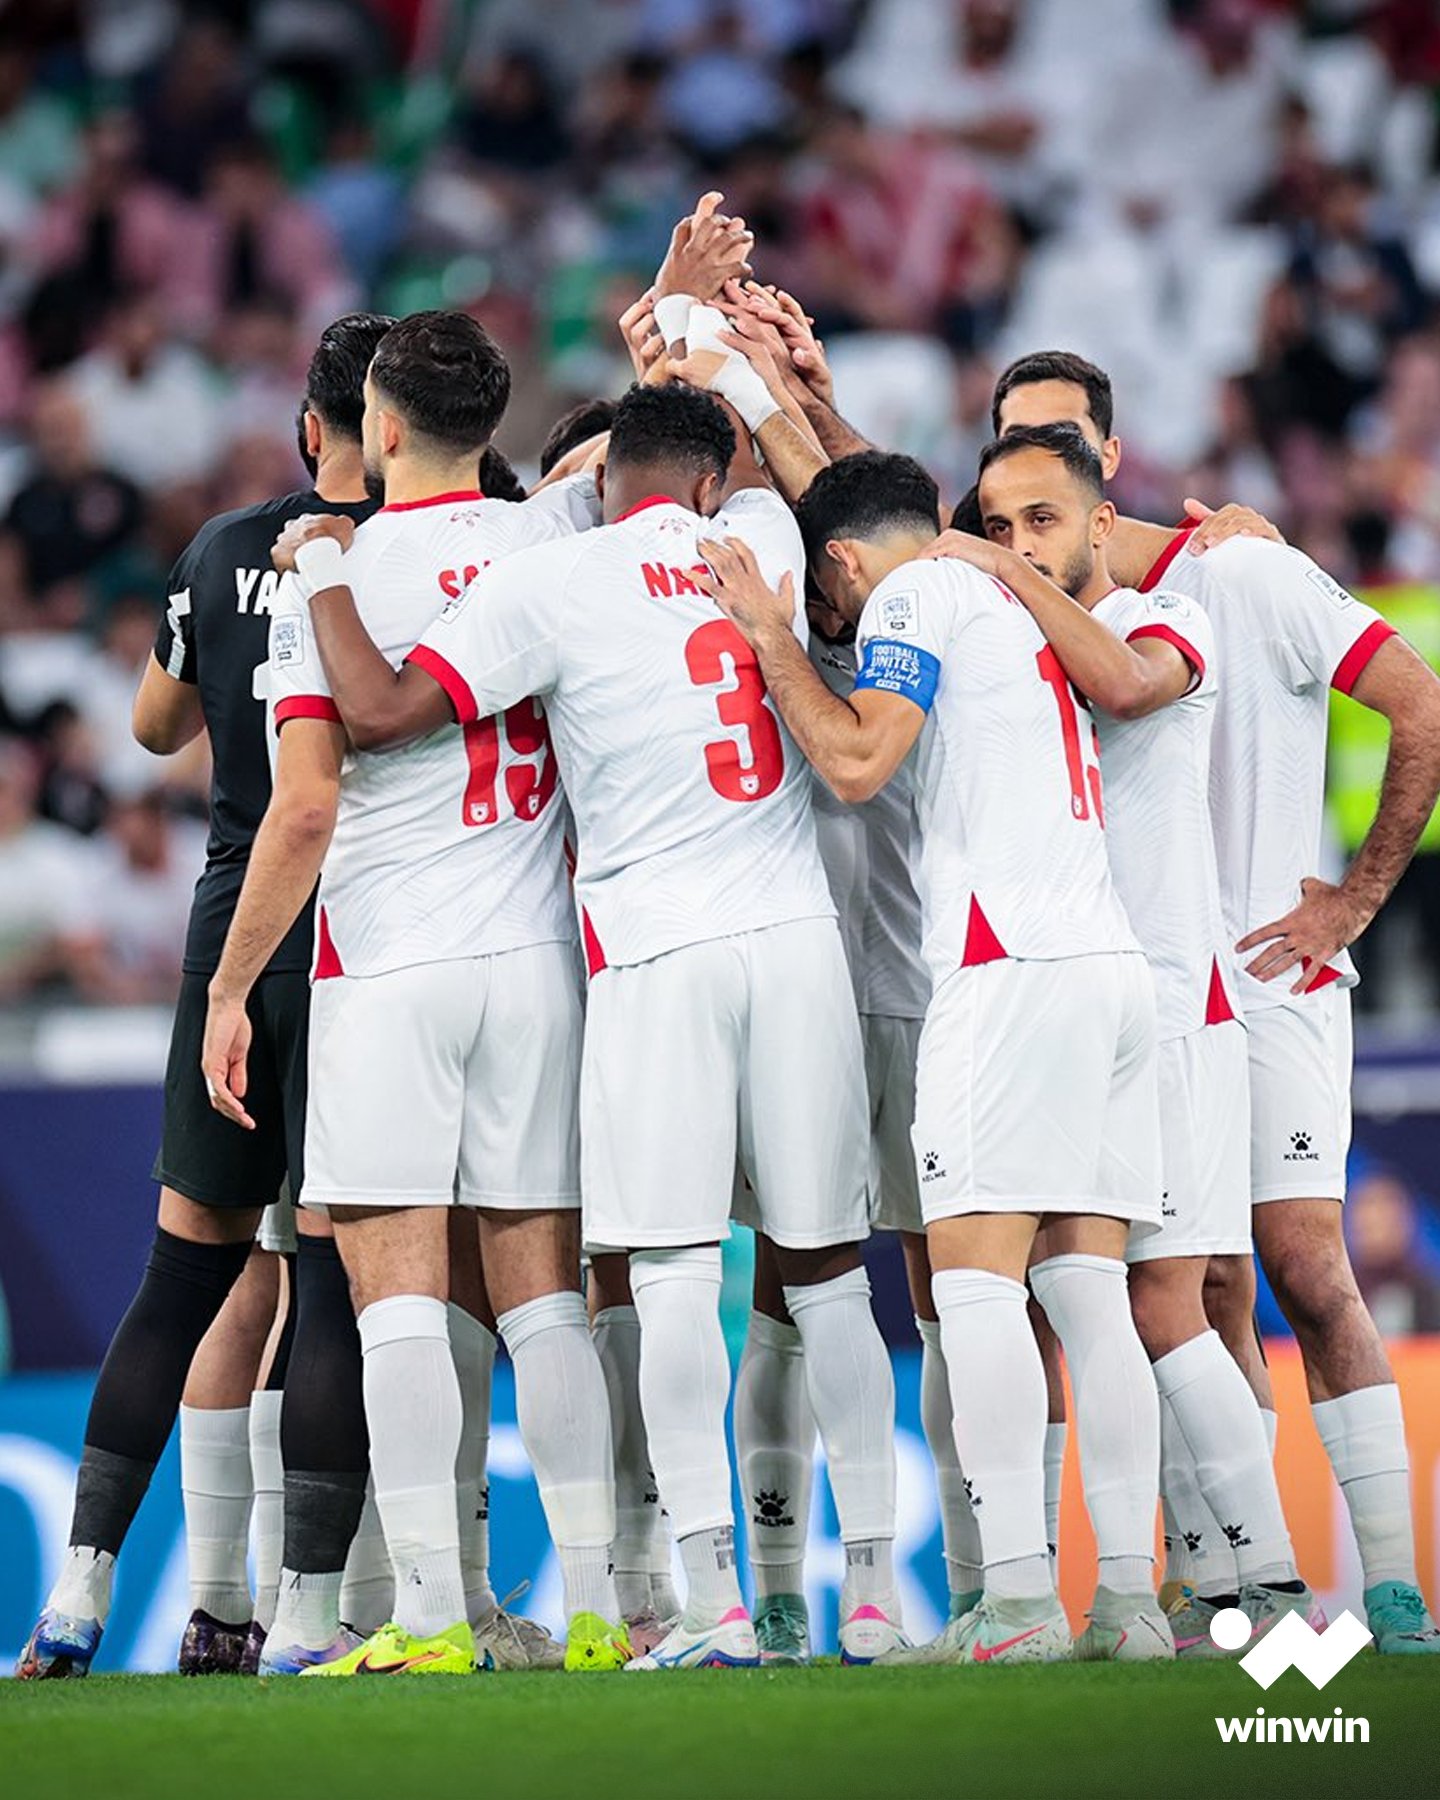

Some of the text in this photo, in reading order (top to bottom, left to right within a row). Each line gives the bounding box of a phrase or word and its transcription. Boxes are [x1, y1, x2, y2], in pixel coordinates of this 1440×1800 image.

[641, 562, 714, 598] NA
[870, 656, 920, 675] UNITES
[684, 618, 785, 802] 3
[1283, 1152, 1320, 1161] KELME
